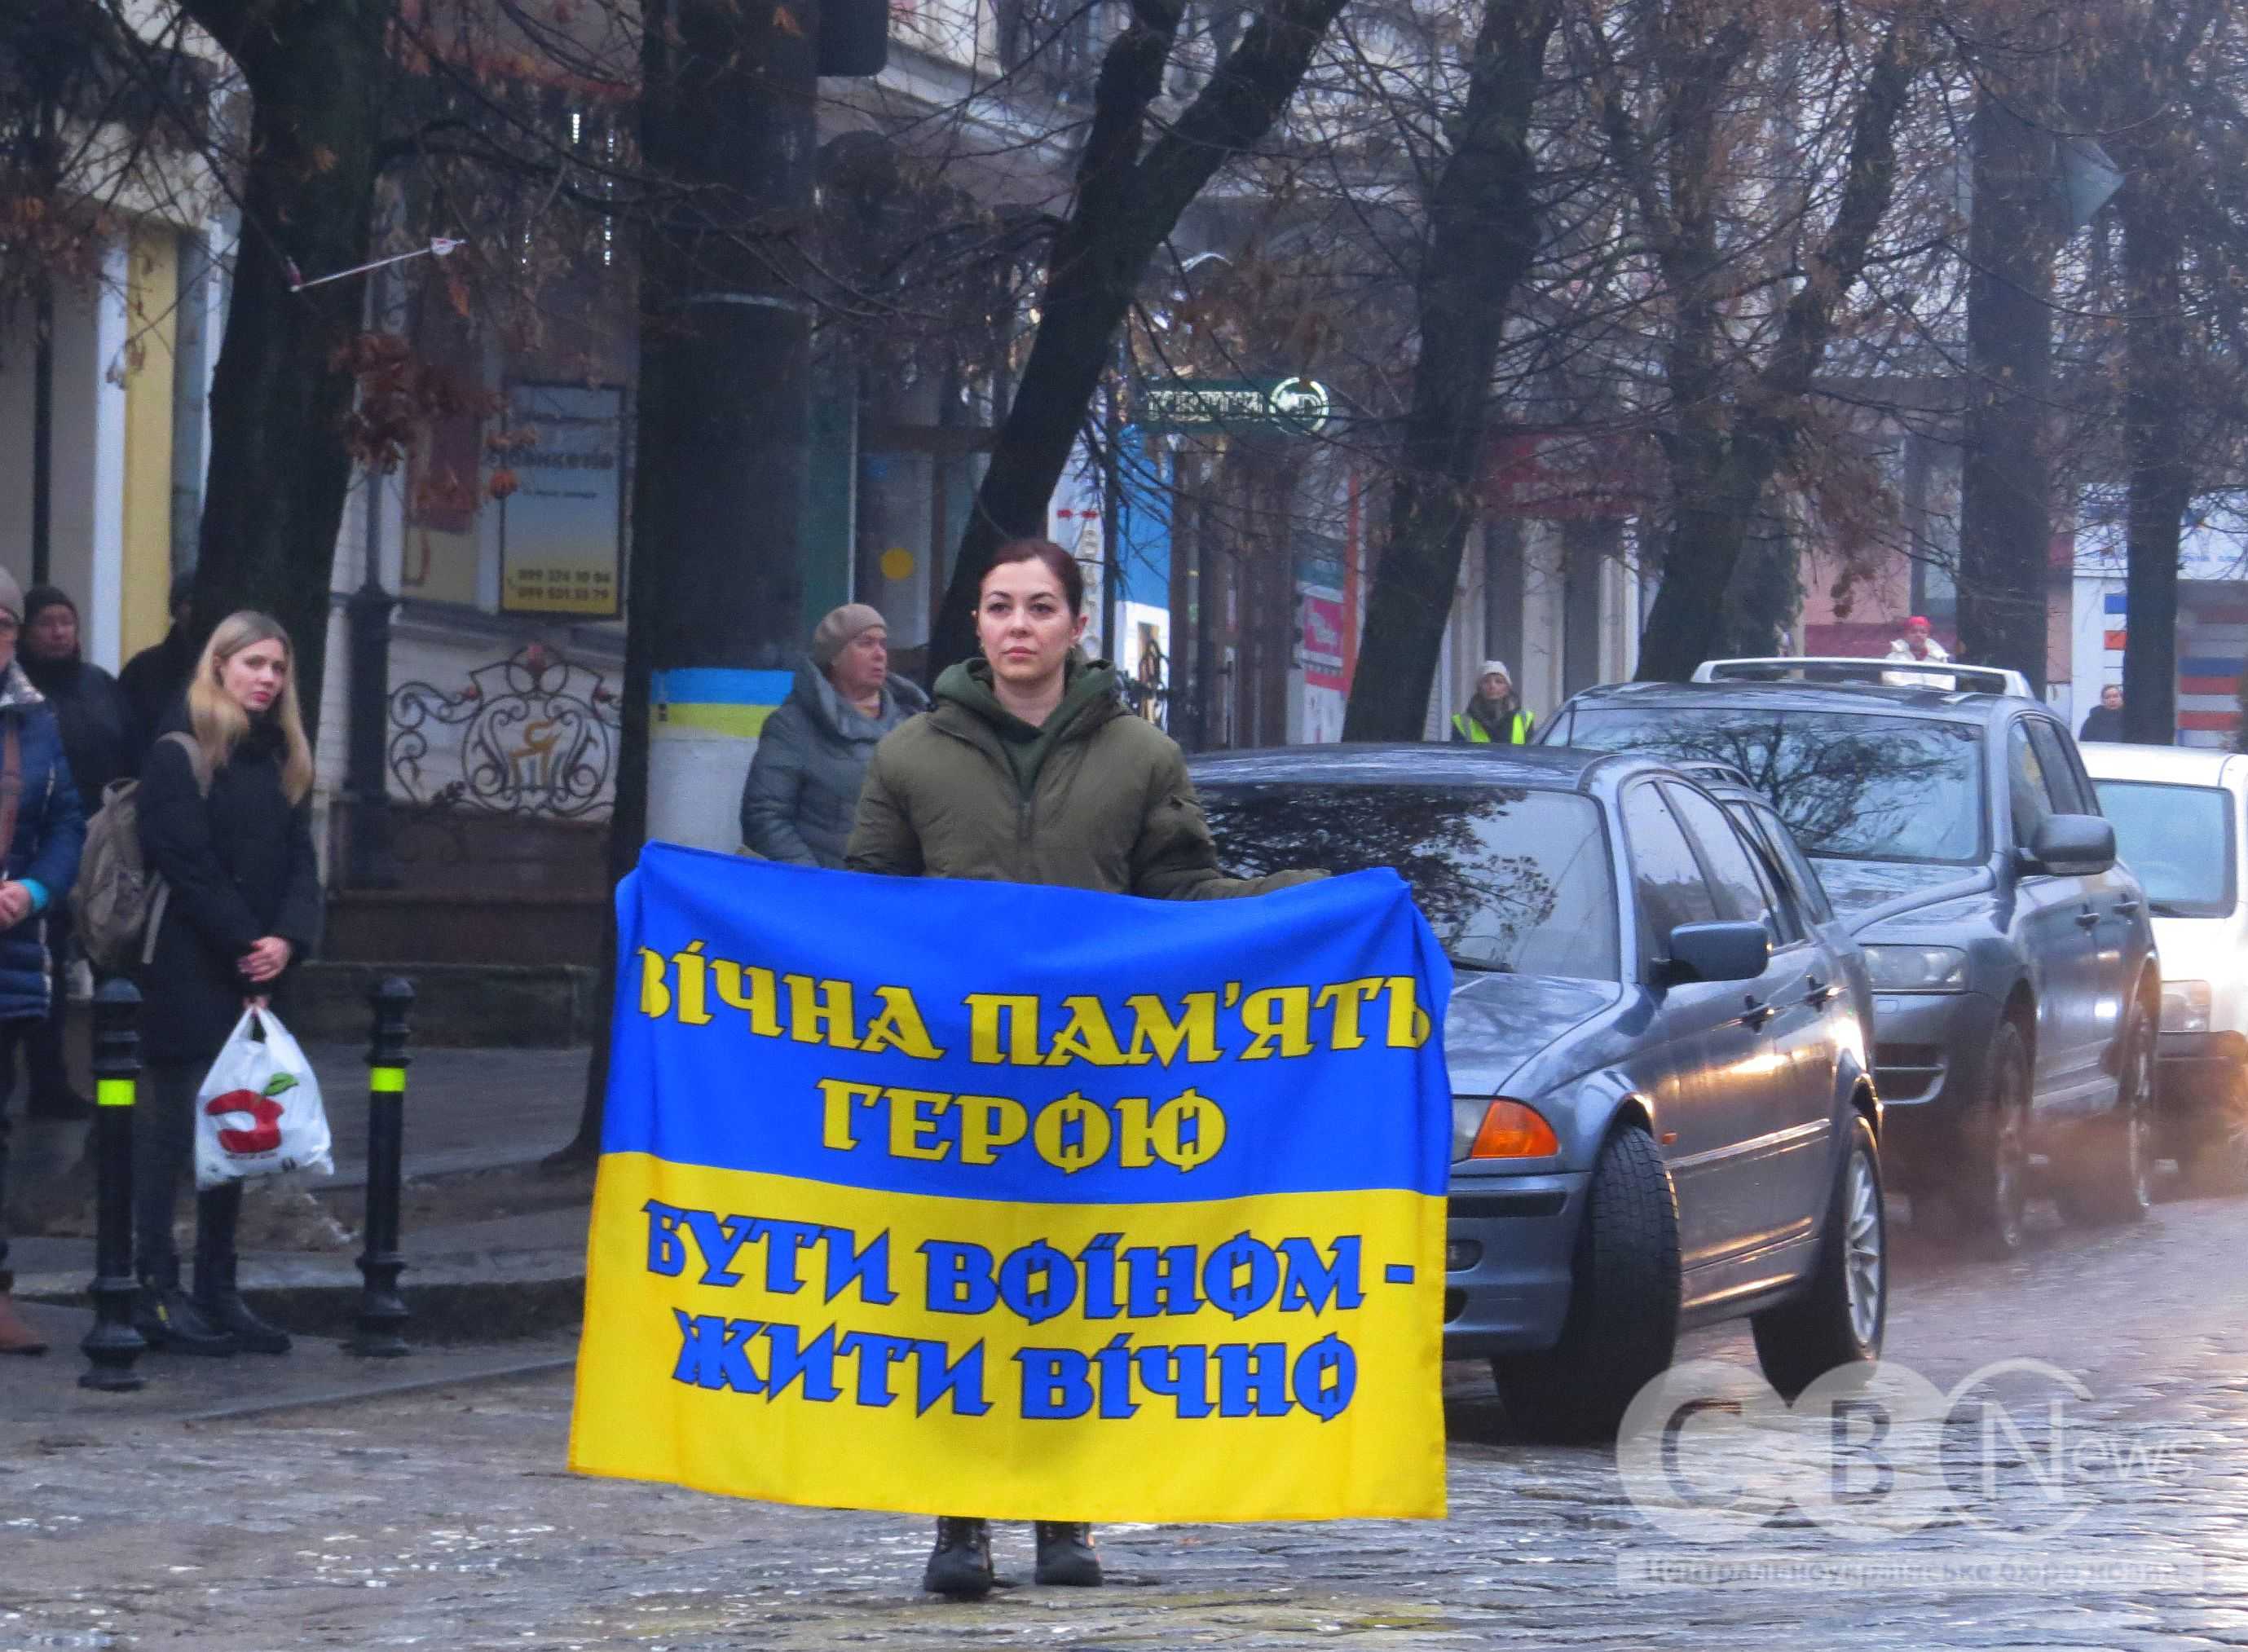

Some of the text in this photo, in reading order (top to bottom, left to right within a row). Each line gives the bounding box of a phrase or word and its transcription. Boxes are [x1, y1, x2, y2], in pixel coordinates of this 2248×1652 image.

[963, 975, 1431, 1068] ПАМ'ЯТЬ
[816, 1077, 1228, 1174] ГЕРОЮ
[641, 1198, 900, 1306] БУТИ
[915, 1230, 1367, 1326] ВОЇНОМ
[672, 1306, 1357, 1422] ЖИТИ ВІЧНО
